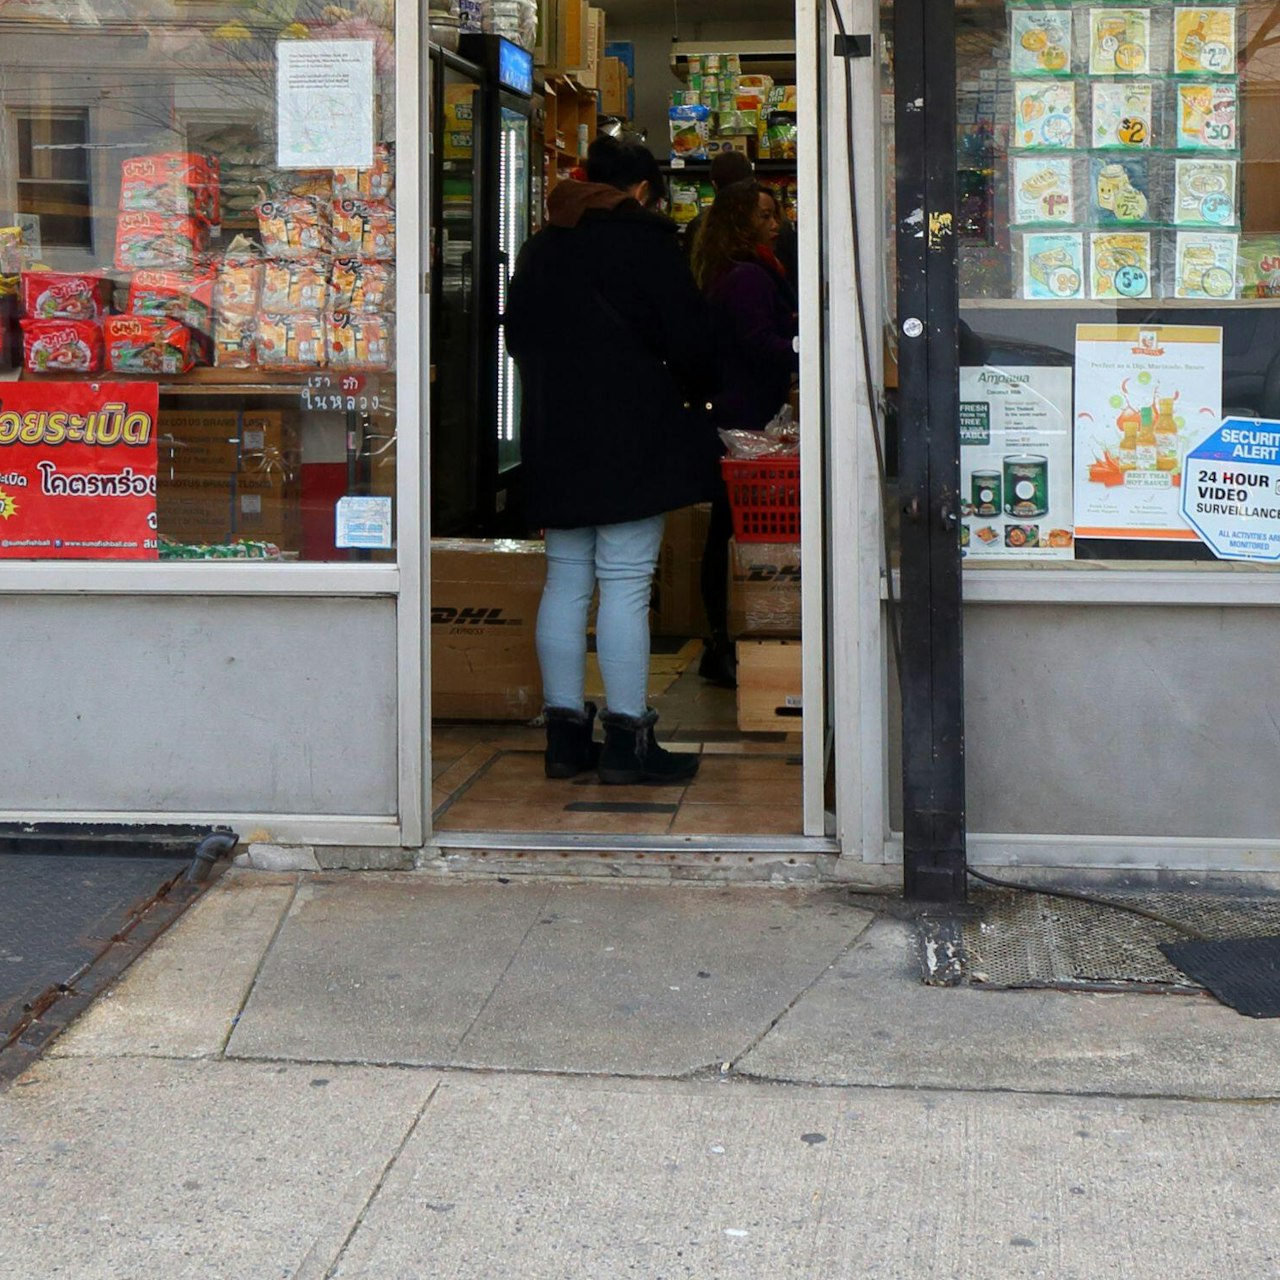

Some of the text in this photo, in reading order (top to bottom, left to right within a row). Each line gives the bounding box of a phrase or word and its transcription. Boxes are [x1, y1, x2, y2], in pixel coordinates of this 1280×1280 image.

[307, 376, 331, 388] เรา
[302, 388, 380, 410] ในหลวง
[960, 404, 988, 412] FRESH
[1232, 446, 1280, 460] ALERT
[1198, 470, 1270, 488] 24 HOUR
[1198, 486, 1248, 502] VIDEO
[1219, 529, 1231, 538] ALL
[1232, 531, 1268, 541] ACTIVITIES
[1228, 540, 1270, 551] MONITORED
[431, 606, 507, 625] DHL
